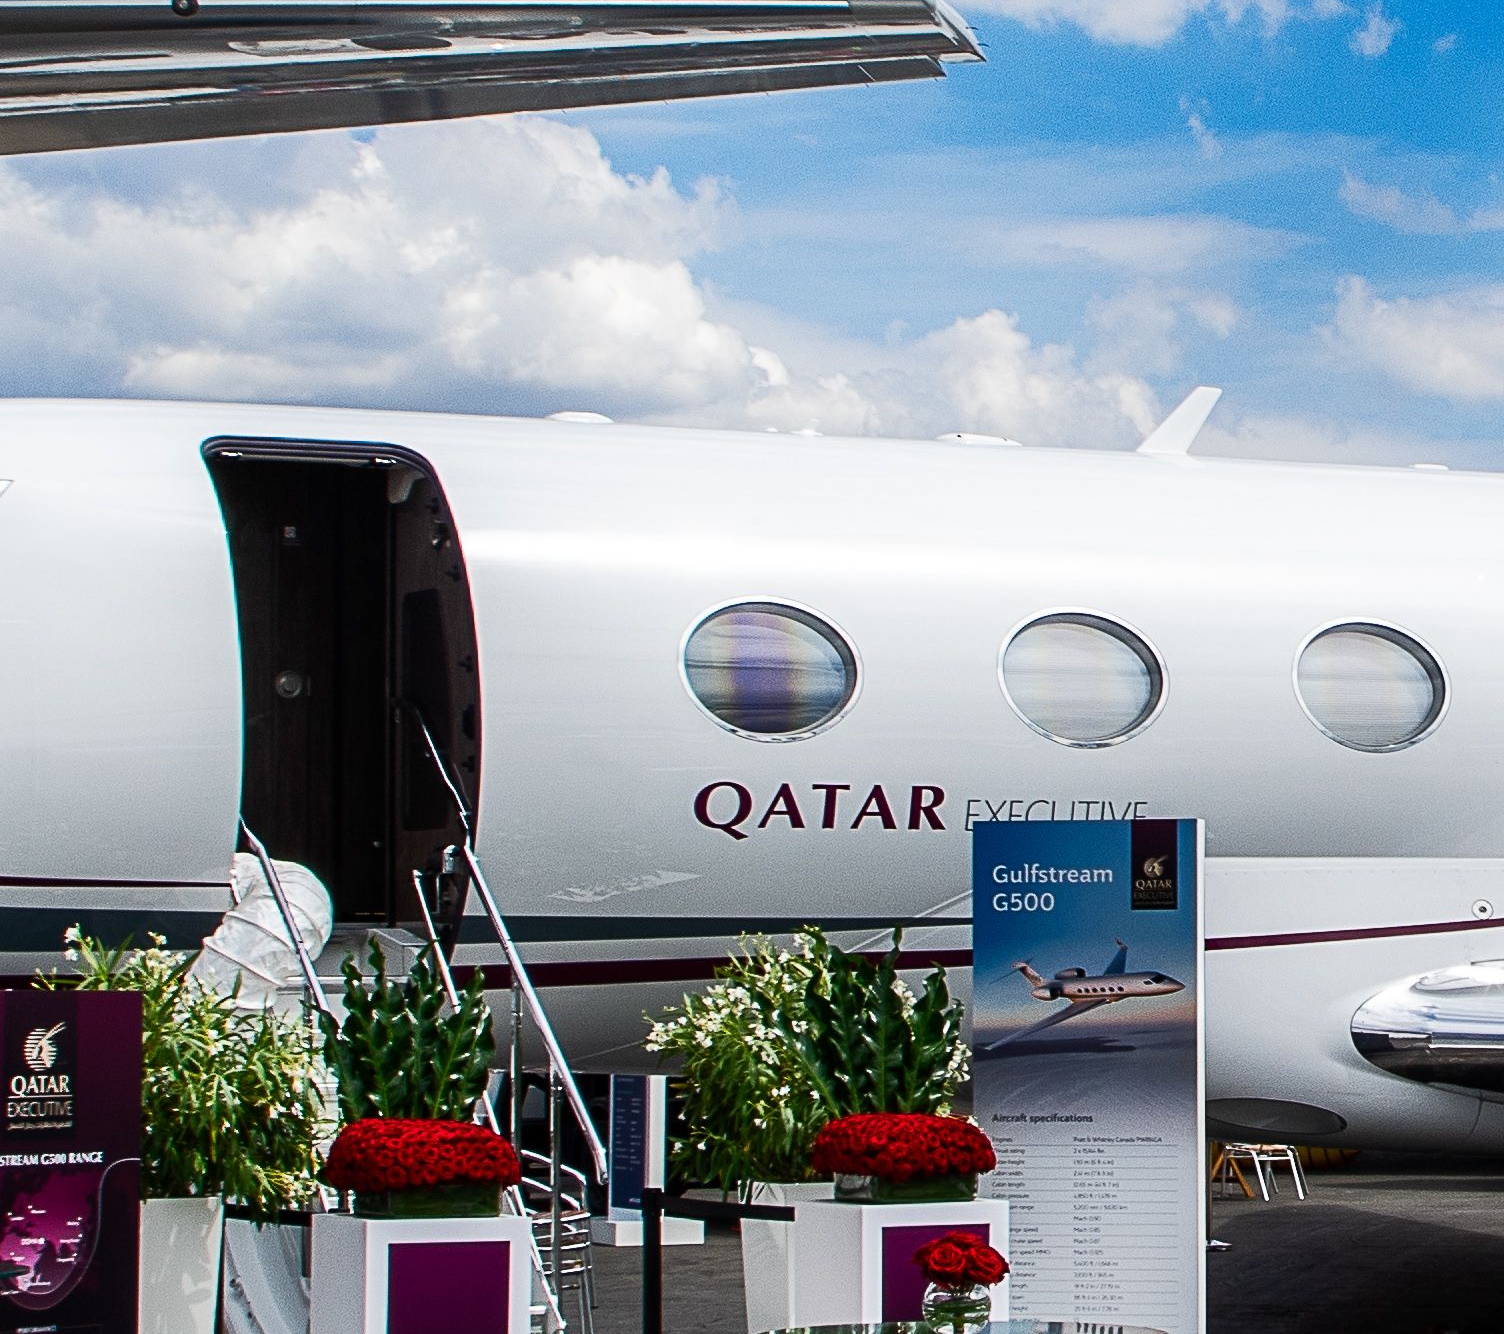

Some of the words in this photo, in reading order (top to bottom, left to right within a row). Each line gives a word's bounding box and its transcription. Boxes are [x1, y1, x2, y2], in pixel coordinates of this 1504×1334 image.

[694, 781, 946, 840] QATAR
[965, 799, 1149, 831] EXECUTIVE
[992, 863, 1113, 883] Gulfstream
[1135, 879, 1172, 890] QATAR
[992, 893, 1055, 911] G500
[11, 1075, 69, 1097] QATAR
[7, 1101, 73, 1117] EXECUTIVE
[992, 1113, 1027, 1123] Aircraft
[1030, 1113, 1093, 1124] specifications
[69, 1152, 103, 1163] RANGE
